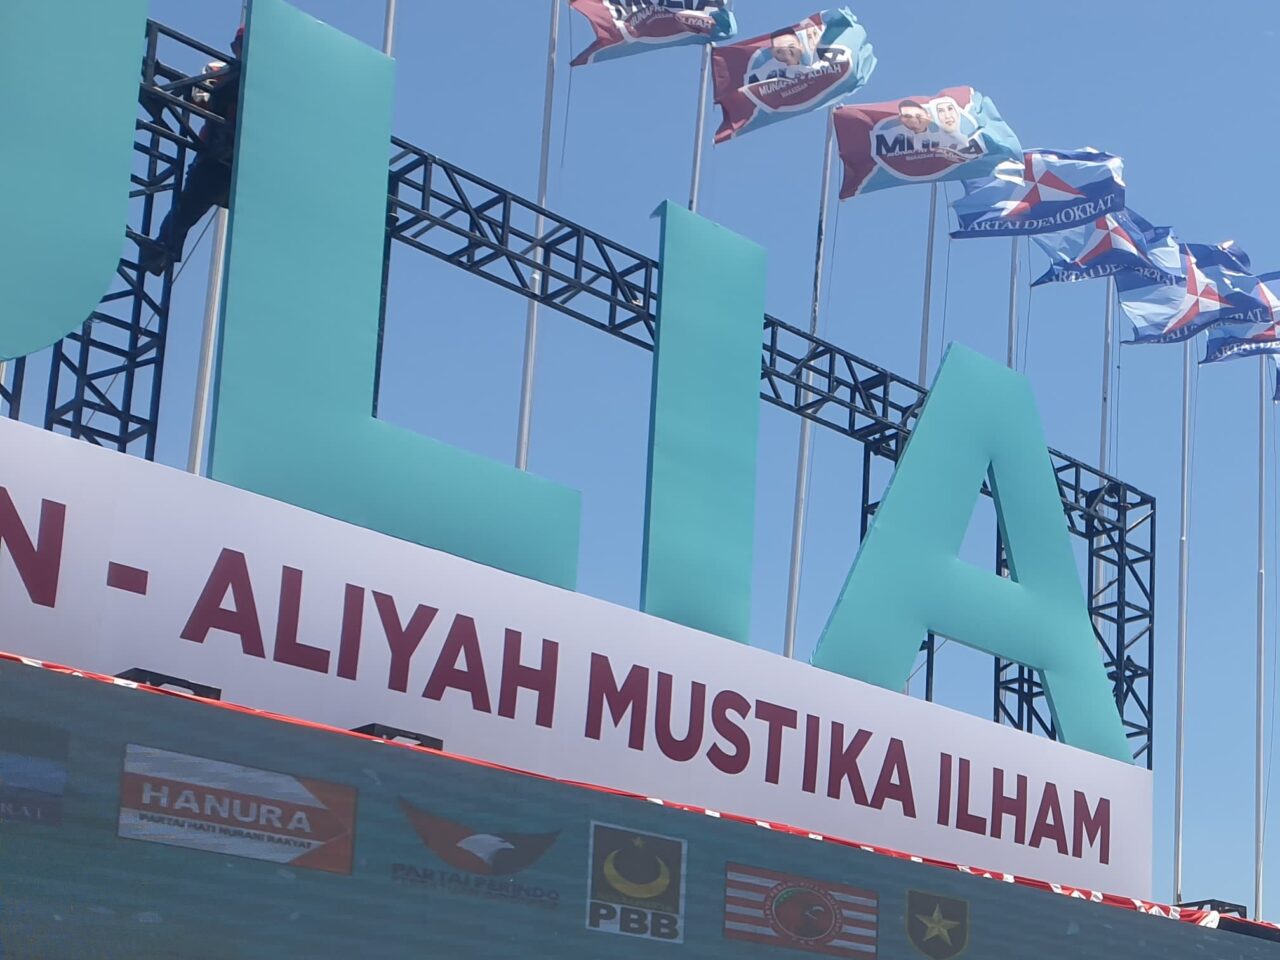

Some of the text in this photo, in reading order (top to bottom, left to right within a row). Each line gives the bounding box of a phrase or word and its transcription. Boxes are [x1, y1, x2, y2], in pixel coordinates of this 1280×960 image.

[961, 193, 1116, 232] ARTAI DEMOKRAT
[1211, 341, 1256, 359] ARTAI
[180, 548, 559, 728] ALIYAH
[584, 652, 917, 819] MUSTIKA
[937, 752, 1111, 865] ILHAM
[142, 782, 312, 834] HANURA
[588, 901, 680, 941] PBB
